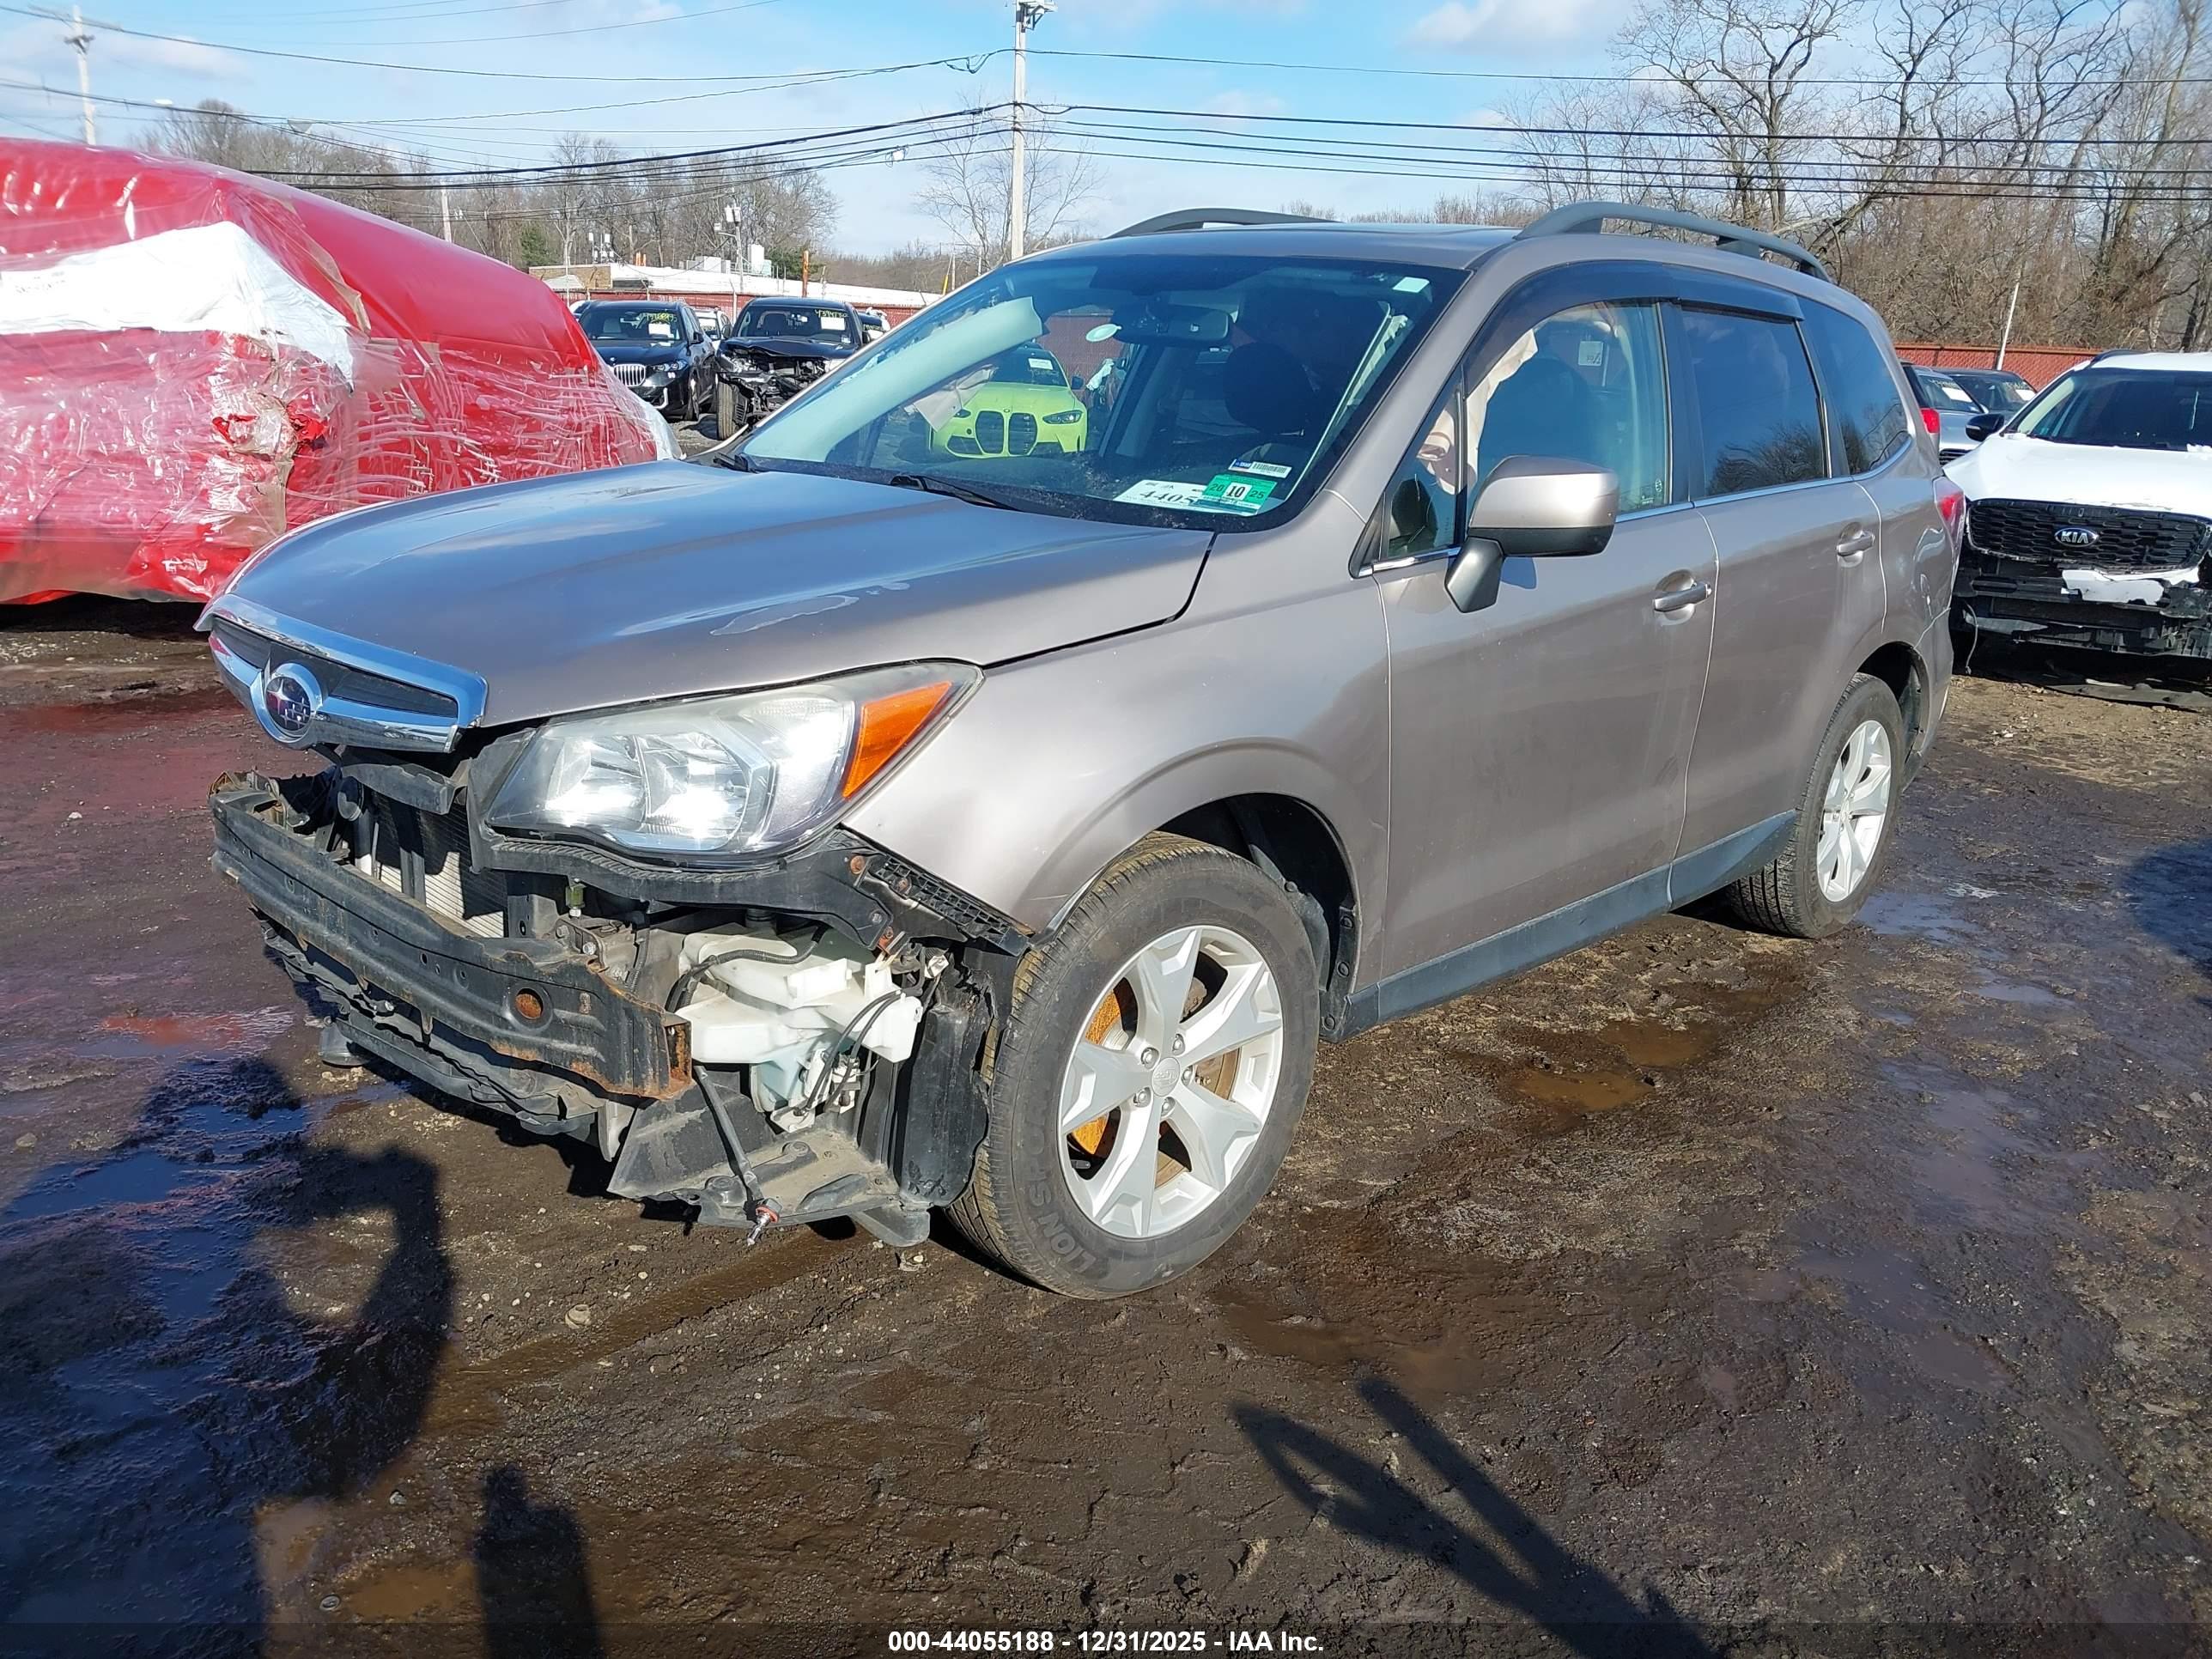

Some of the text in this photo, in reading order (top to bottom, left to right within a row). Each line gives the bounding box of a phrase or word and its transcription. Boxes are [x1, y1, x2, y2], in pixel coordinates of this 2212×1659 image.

[1209, 483, 1225, 492] 20
[1227, 485, 1245, 497] 10
[1249, 489, 1266, 499] 25
[2061, 531, 2089, 544] KIA
[1037, 1212, 1097, 1273] LION
